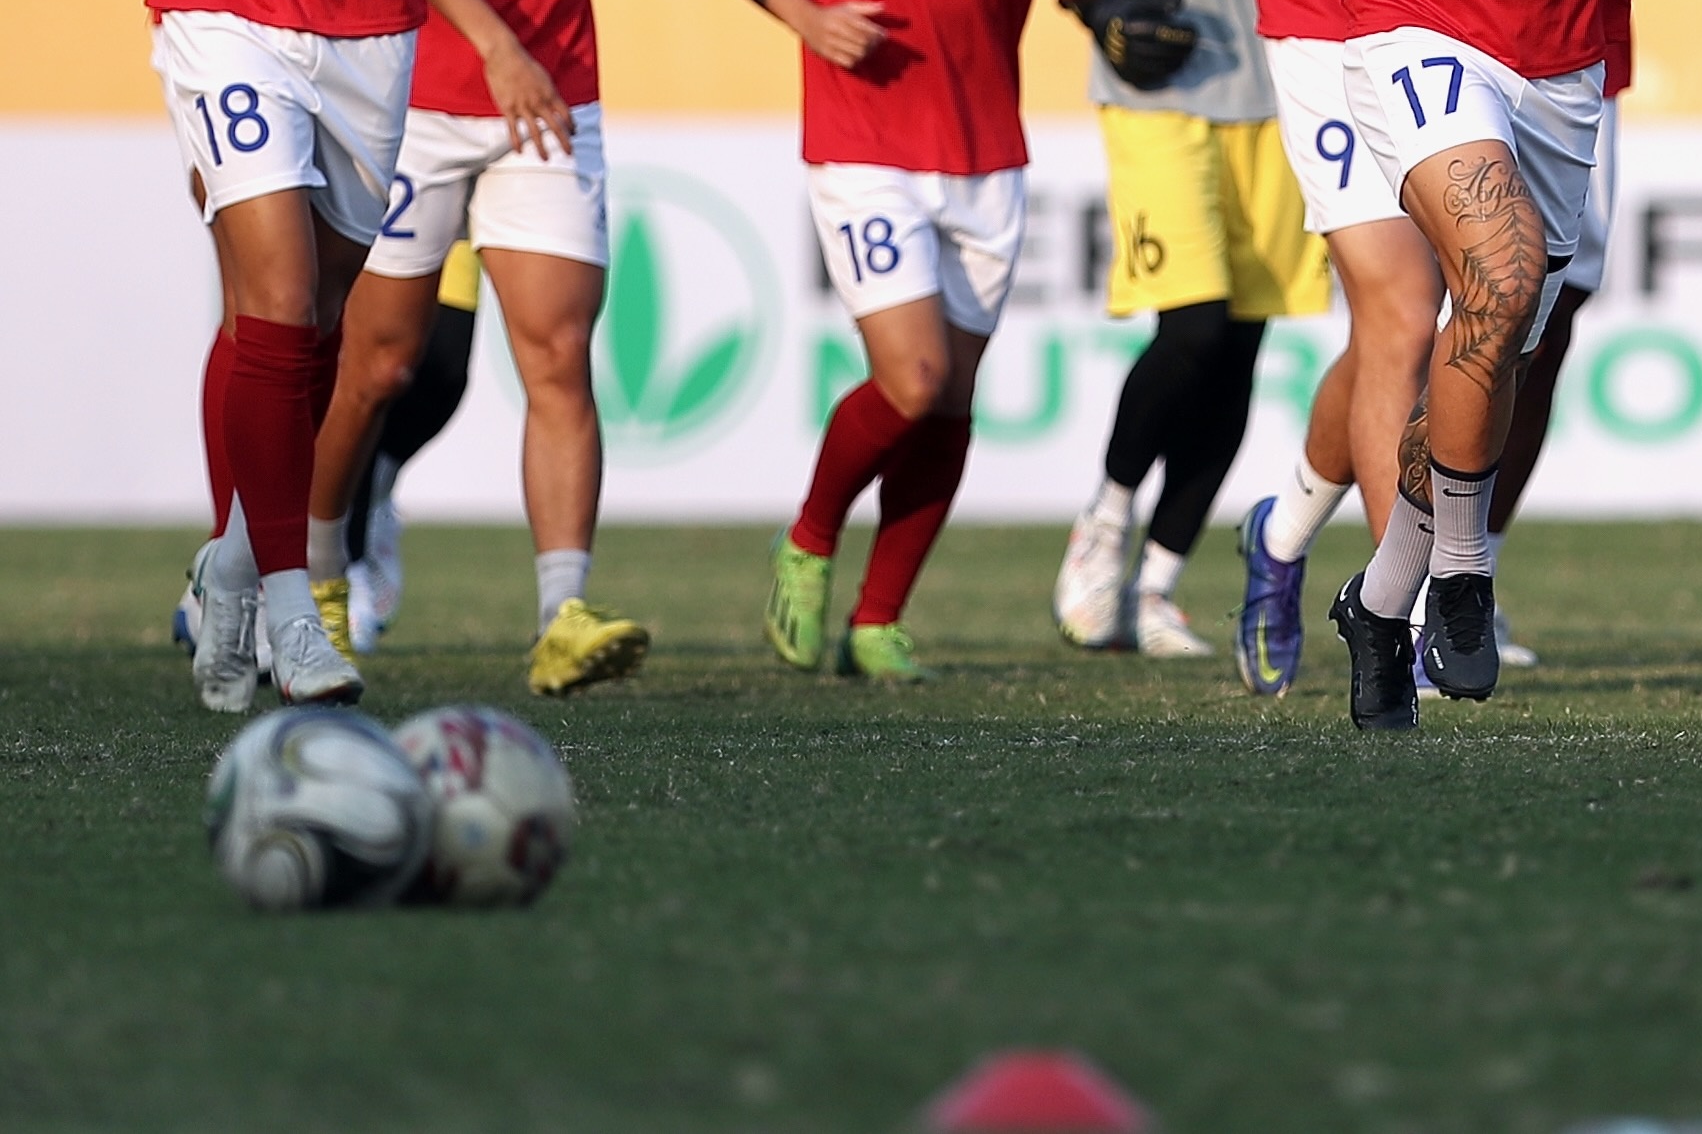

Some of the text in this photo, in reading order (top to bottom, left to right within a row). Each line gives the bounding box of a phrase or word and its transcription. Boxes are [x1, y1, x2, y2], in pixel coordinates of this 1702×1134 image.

[195, 82, 270, 166] 18
[1391, 56, 1465, 129] 17
[1315, 119, 1355, 190] 9
[839, 217, 900, 282] 18
[1126, 211, 1164, 279] 16
